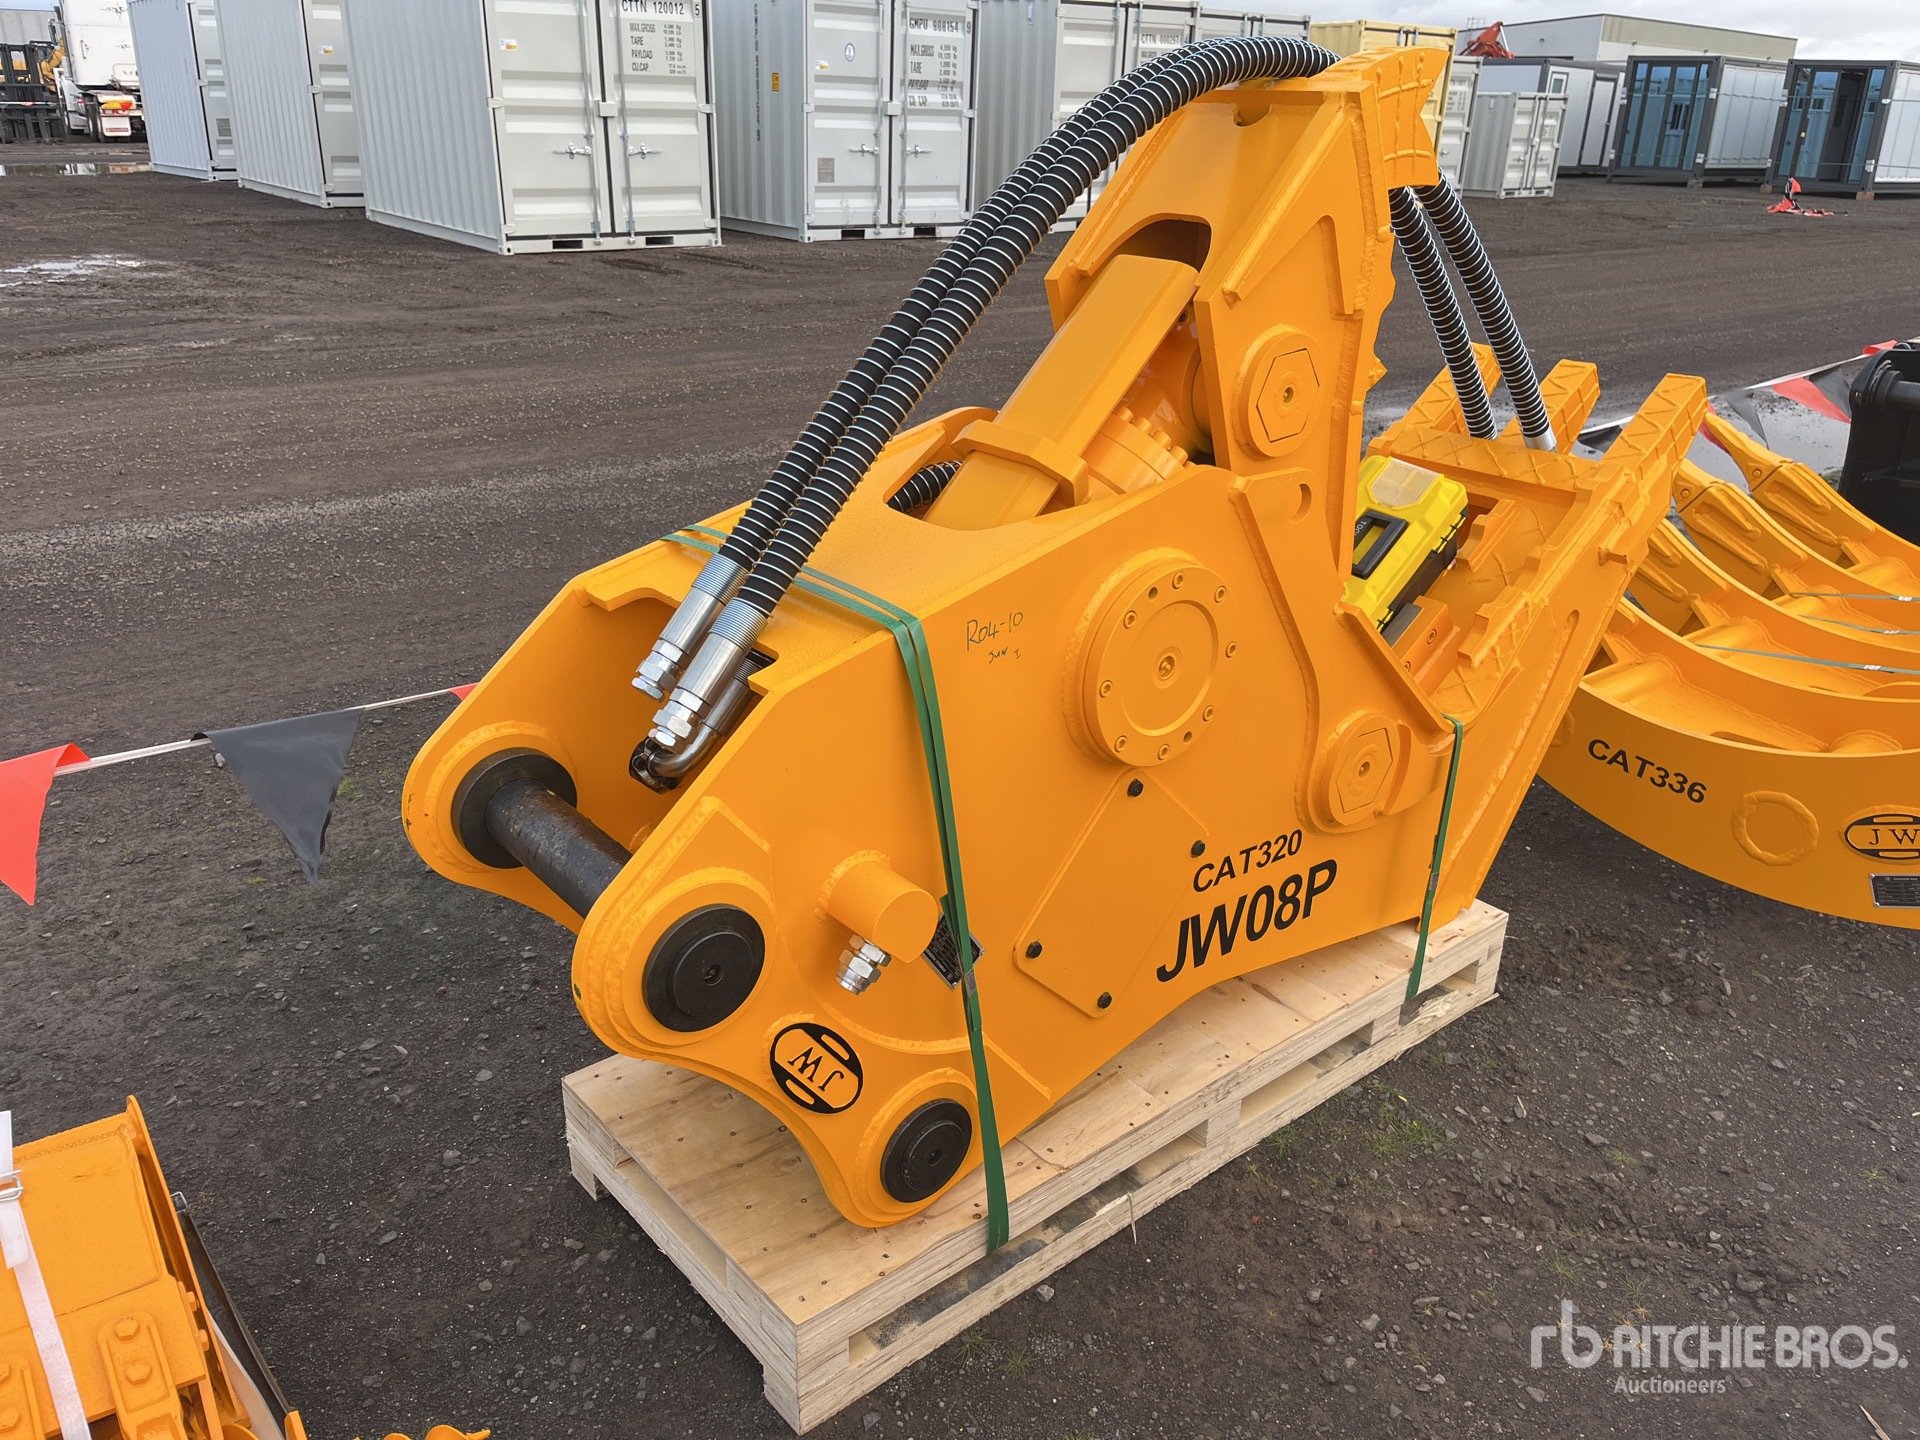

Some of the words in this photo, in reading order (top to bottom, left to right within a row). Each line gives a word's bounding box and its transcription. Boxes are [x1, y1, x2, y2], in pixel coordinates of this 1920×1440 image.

[621, 0, 648, 13] CTTN
[653, 1, 685, 15] 120012
[695, 4, 700, 16] 5
[909, 17, 928, 30] GMPU
[966, 611, 1024, 652] R04-10
[1587, 739, 1708, 804] CAT336
[1192, 829, 1303, 893] CAT320
[1156, 859, 1338, 983] JW08P
[787, 1046, 845, 1092] JW
